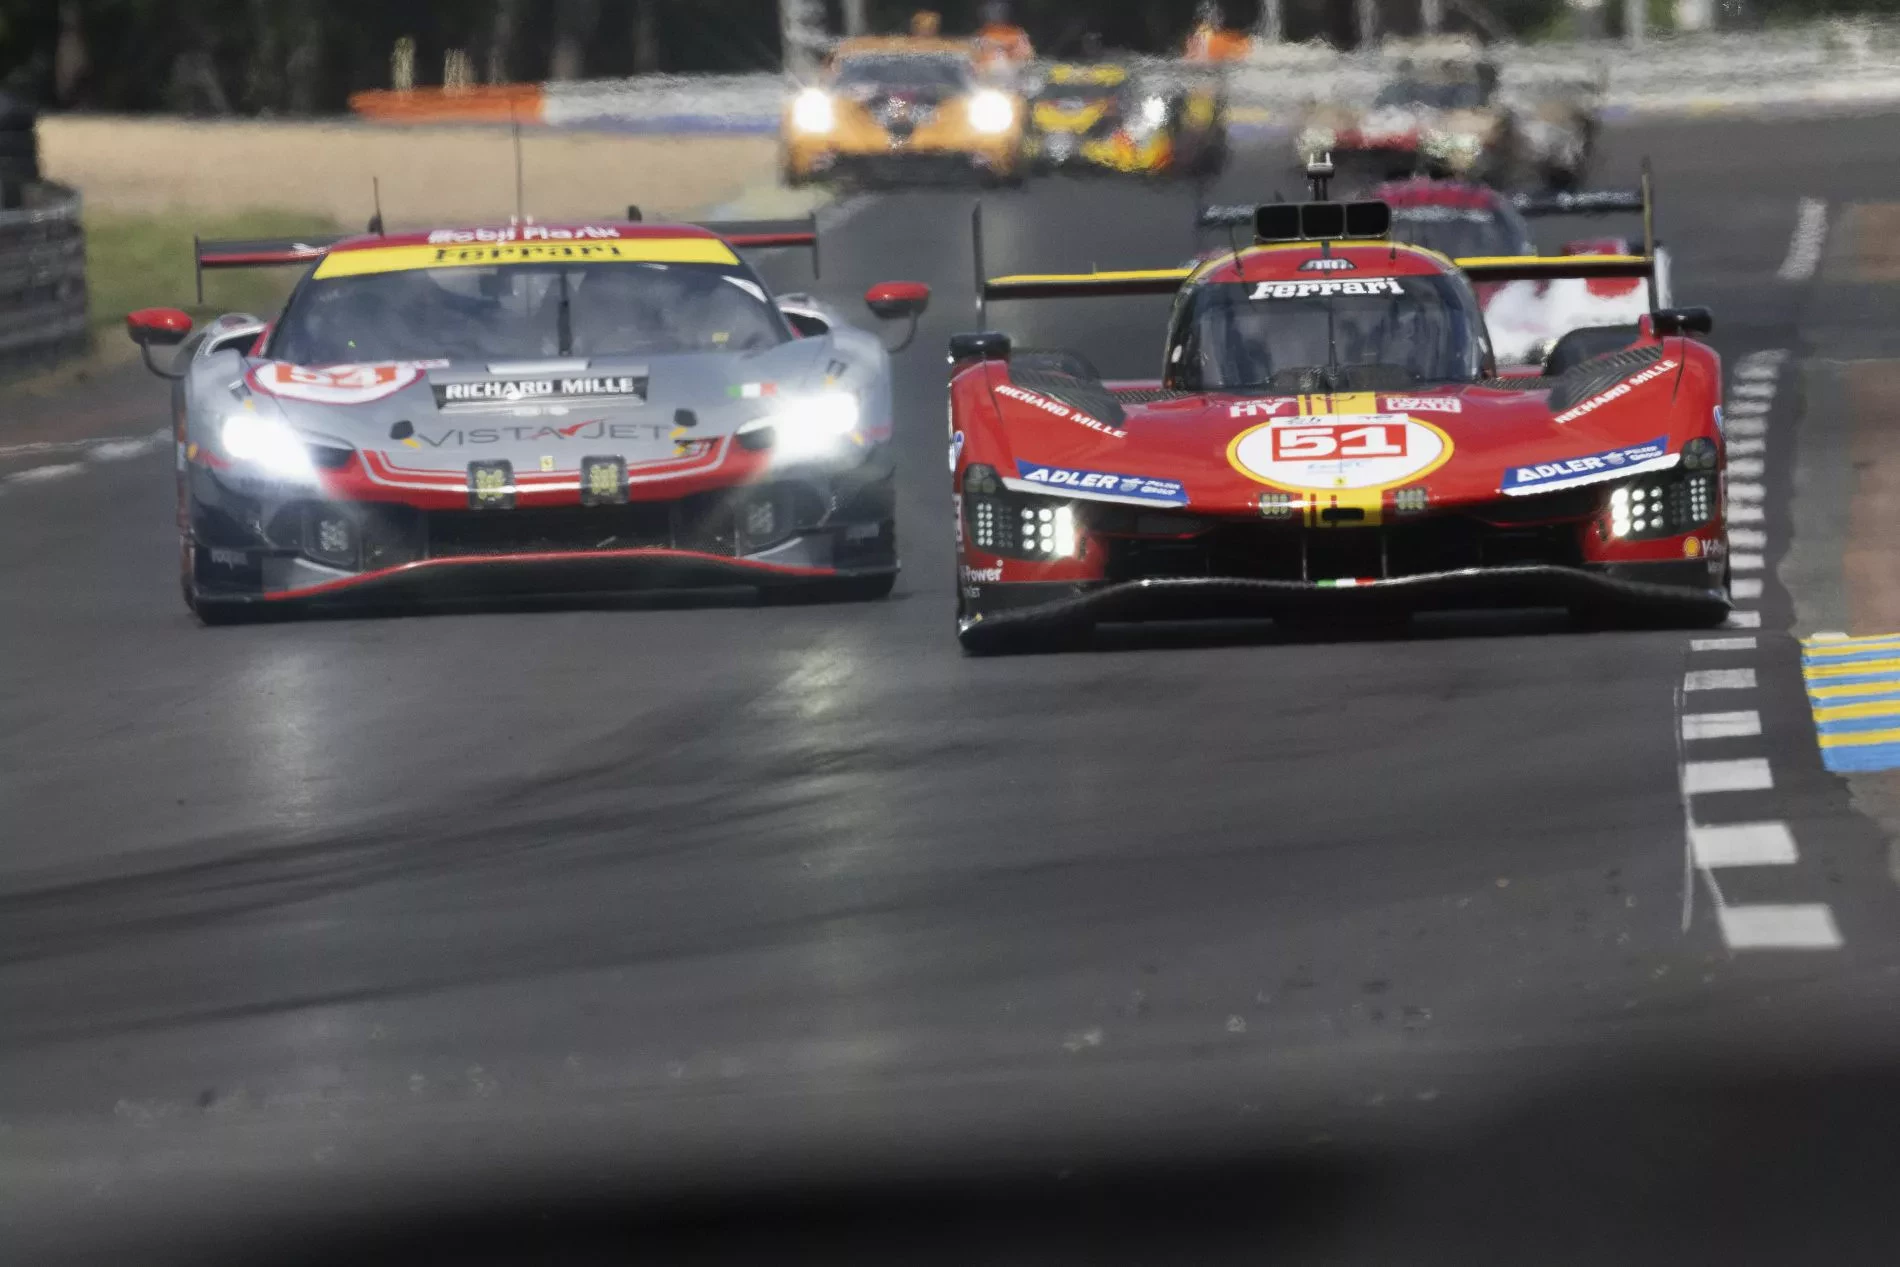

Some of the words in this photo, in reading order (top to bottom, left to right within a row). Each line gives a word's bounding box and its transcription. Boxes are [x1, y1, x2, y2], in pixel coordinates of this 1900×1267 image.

[1249, 277, 1404, 300] Ferrari
[446, 380, 553, 399] RICHARD
[561, 376, 634, 394] MILLE
[1555, 383, 1631, 424] RICHARD
[1629, 359, 1679, 386] MILLE
[995, 385, 1070, 418] RICHARD
[1070, 412, 1128, 438] MILLE
[1279, 426, 1402, 458] 51
[1023, 468, 1120, 489] ADLER
[1516, 456, 1607, 482] ADLER
